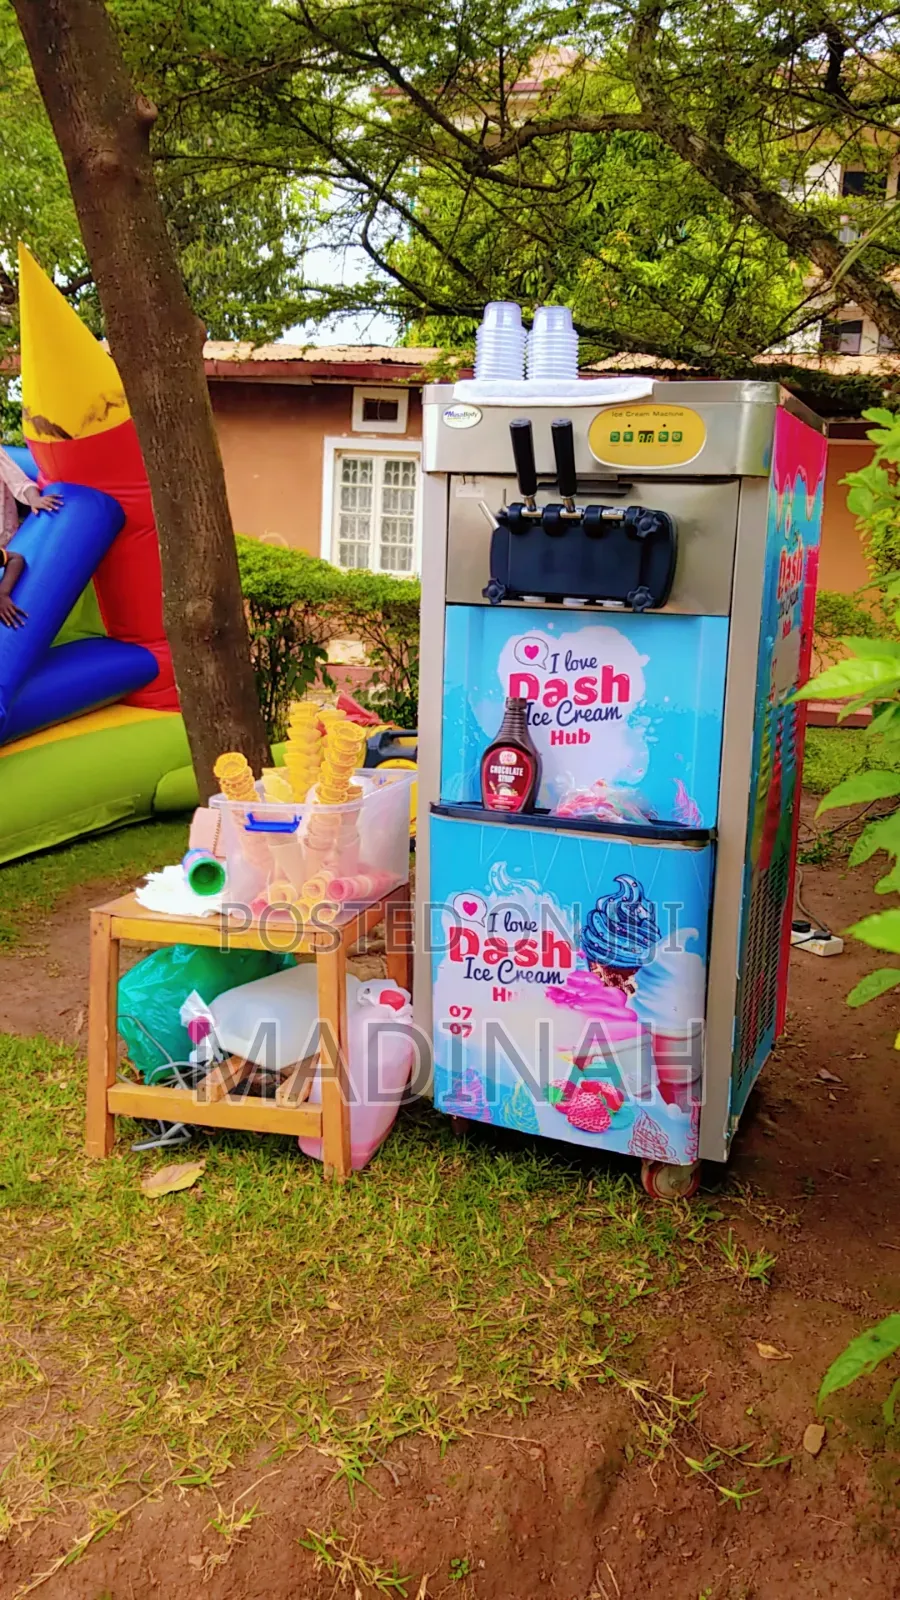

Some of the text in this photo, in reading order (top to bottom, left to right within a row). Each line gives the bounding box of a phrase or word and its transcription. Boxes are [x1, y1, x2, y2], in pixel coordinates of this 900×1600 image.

[549, 649, 598, 674] I love
[509, 665, 630, 708] Dash
[526, 700, 622, 727] Ice Cream
[550, 728, 591, 746] Hub
[490, 765, 524, 777] CHOCOLATE
[488, 911, 538, 932] I love
[449, 926, 572, 968] Dash
[464, 957, 564, 985] Ice Cream
[449, 1005, 472, 1020] 07
[449, 1023, 472, 1038] 07
